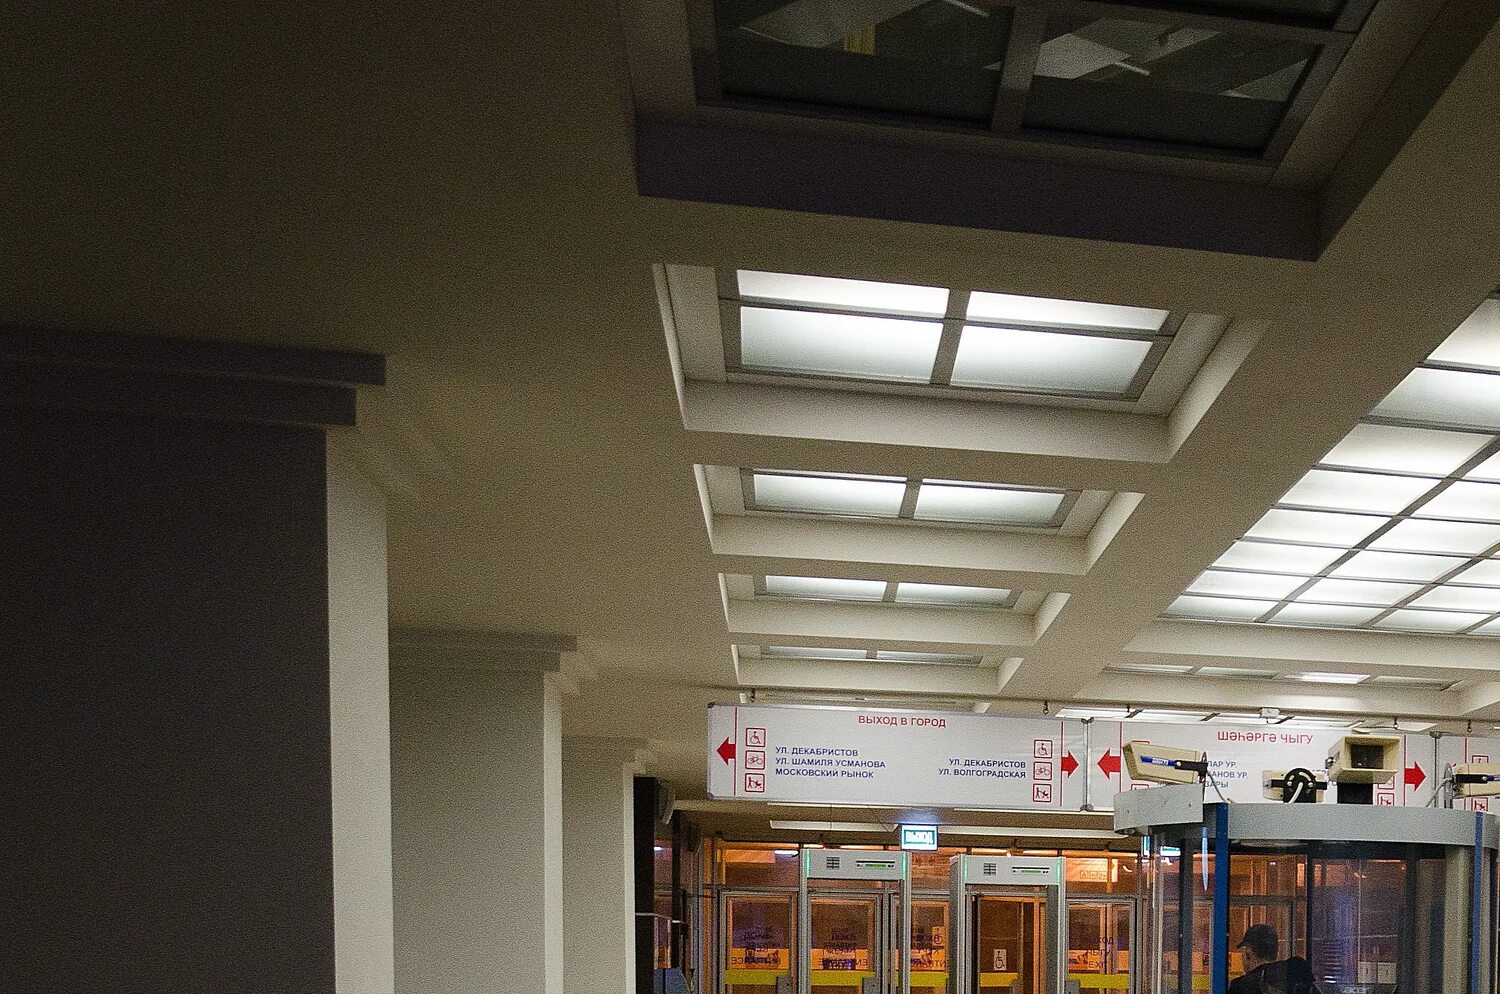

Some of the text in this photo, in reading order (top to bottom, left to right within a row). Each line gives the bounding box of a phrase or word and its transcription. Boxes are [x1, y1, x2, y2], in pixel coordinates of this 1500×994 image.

[859, 715, 946, 729] ВЫХОД В ГОРОД
[1281, 734, 1313, 744] ЧЫГУ
[775, 746, 858, 758] УЛ. ДЕКАБРИСТОВ
[775, 757, 886, 769] УЛ. ШАМИЛЯ УСМАНОВА
[949, 758, 1026, 769] УЛ. ДЕКАБРИСТОВ
[775, 768, 874, 779] МОСКОВСКИЙ РЫНОК
[939, 768, 1026, 779] УЛ. ВОЛГОГРАДСКАЯ
[1206, 780, 1229, 788] ЗАРЫ
[906, 831, 933, 845] ВЫХОД
